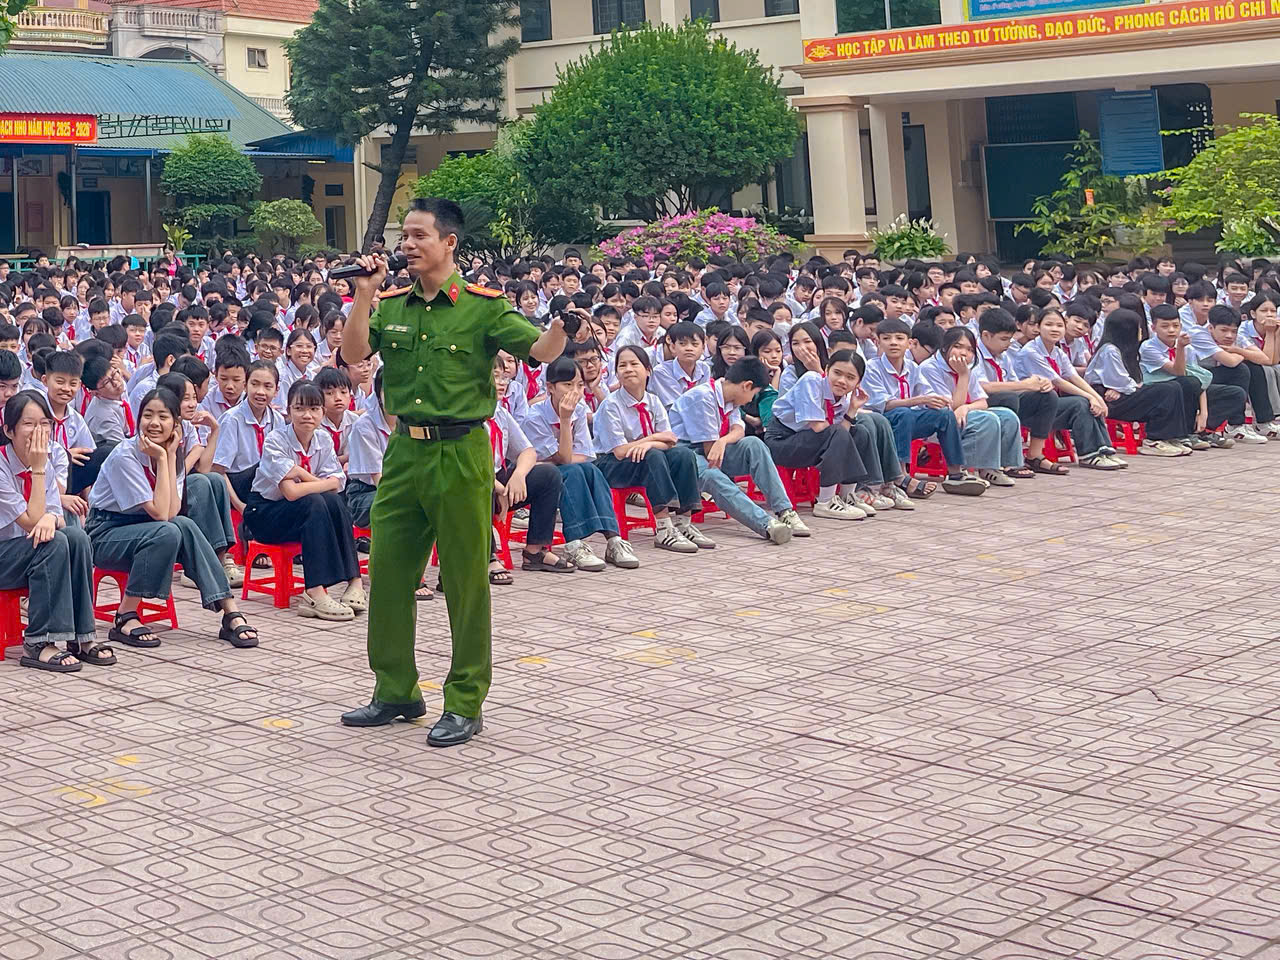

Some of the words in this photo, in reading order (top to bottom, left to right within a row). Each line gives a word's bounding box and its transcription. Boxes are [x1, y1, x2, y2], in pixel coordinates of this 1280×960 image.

[836, 41, 860, 59] HỌC
[863, 38, 886, 56] TẬP
[889, 35, 906, 52] VÀ
[908, 32, 935, 50] LÀM
[938, 30, 970, 47] THEO
[973, 27, 991, 44] TƯ
[993, 20, 1042, 41] TƯỞNG,
[1045, 21, 1073, 39] ĐẠO
[1077, 14, 1111, 33] ĐỨC,
[1114, 11, 1165, 30] PHONG
[1169, 5, 1210, 25] CÁCH
[1214, 0, 1235, 20] HỒ
[28, 117, 42, 136] NĂM
[43, 120, 56, 139] HỌC
